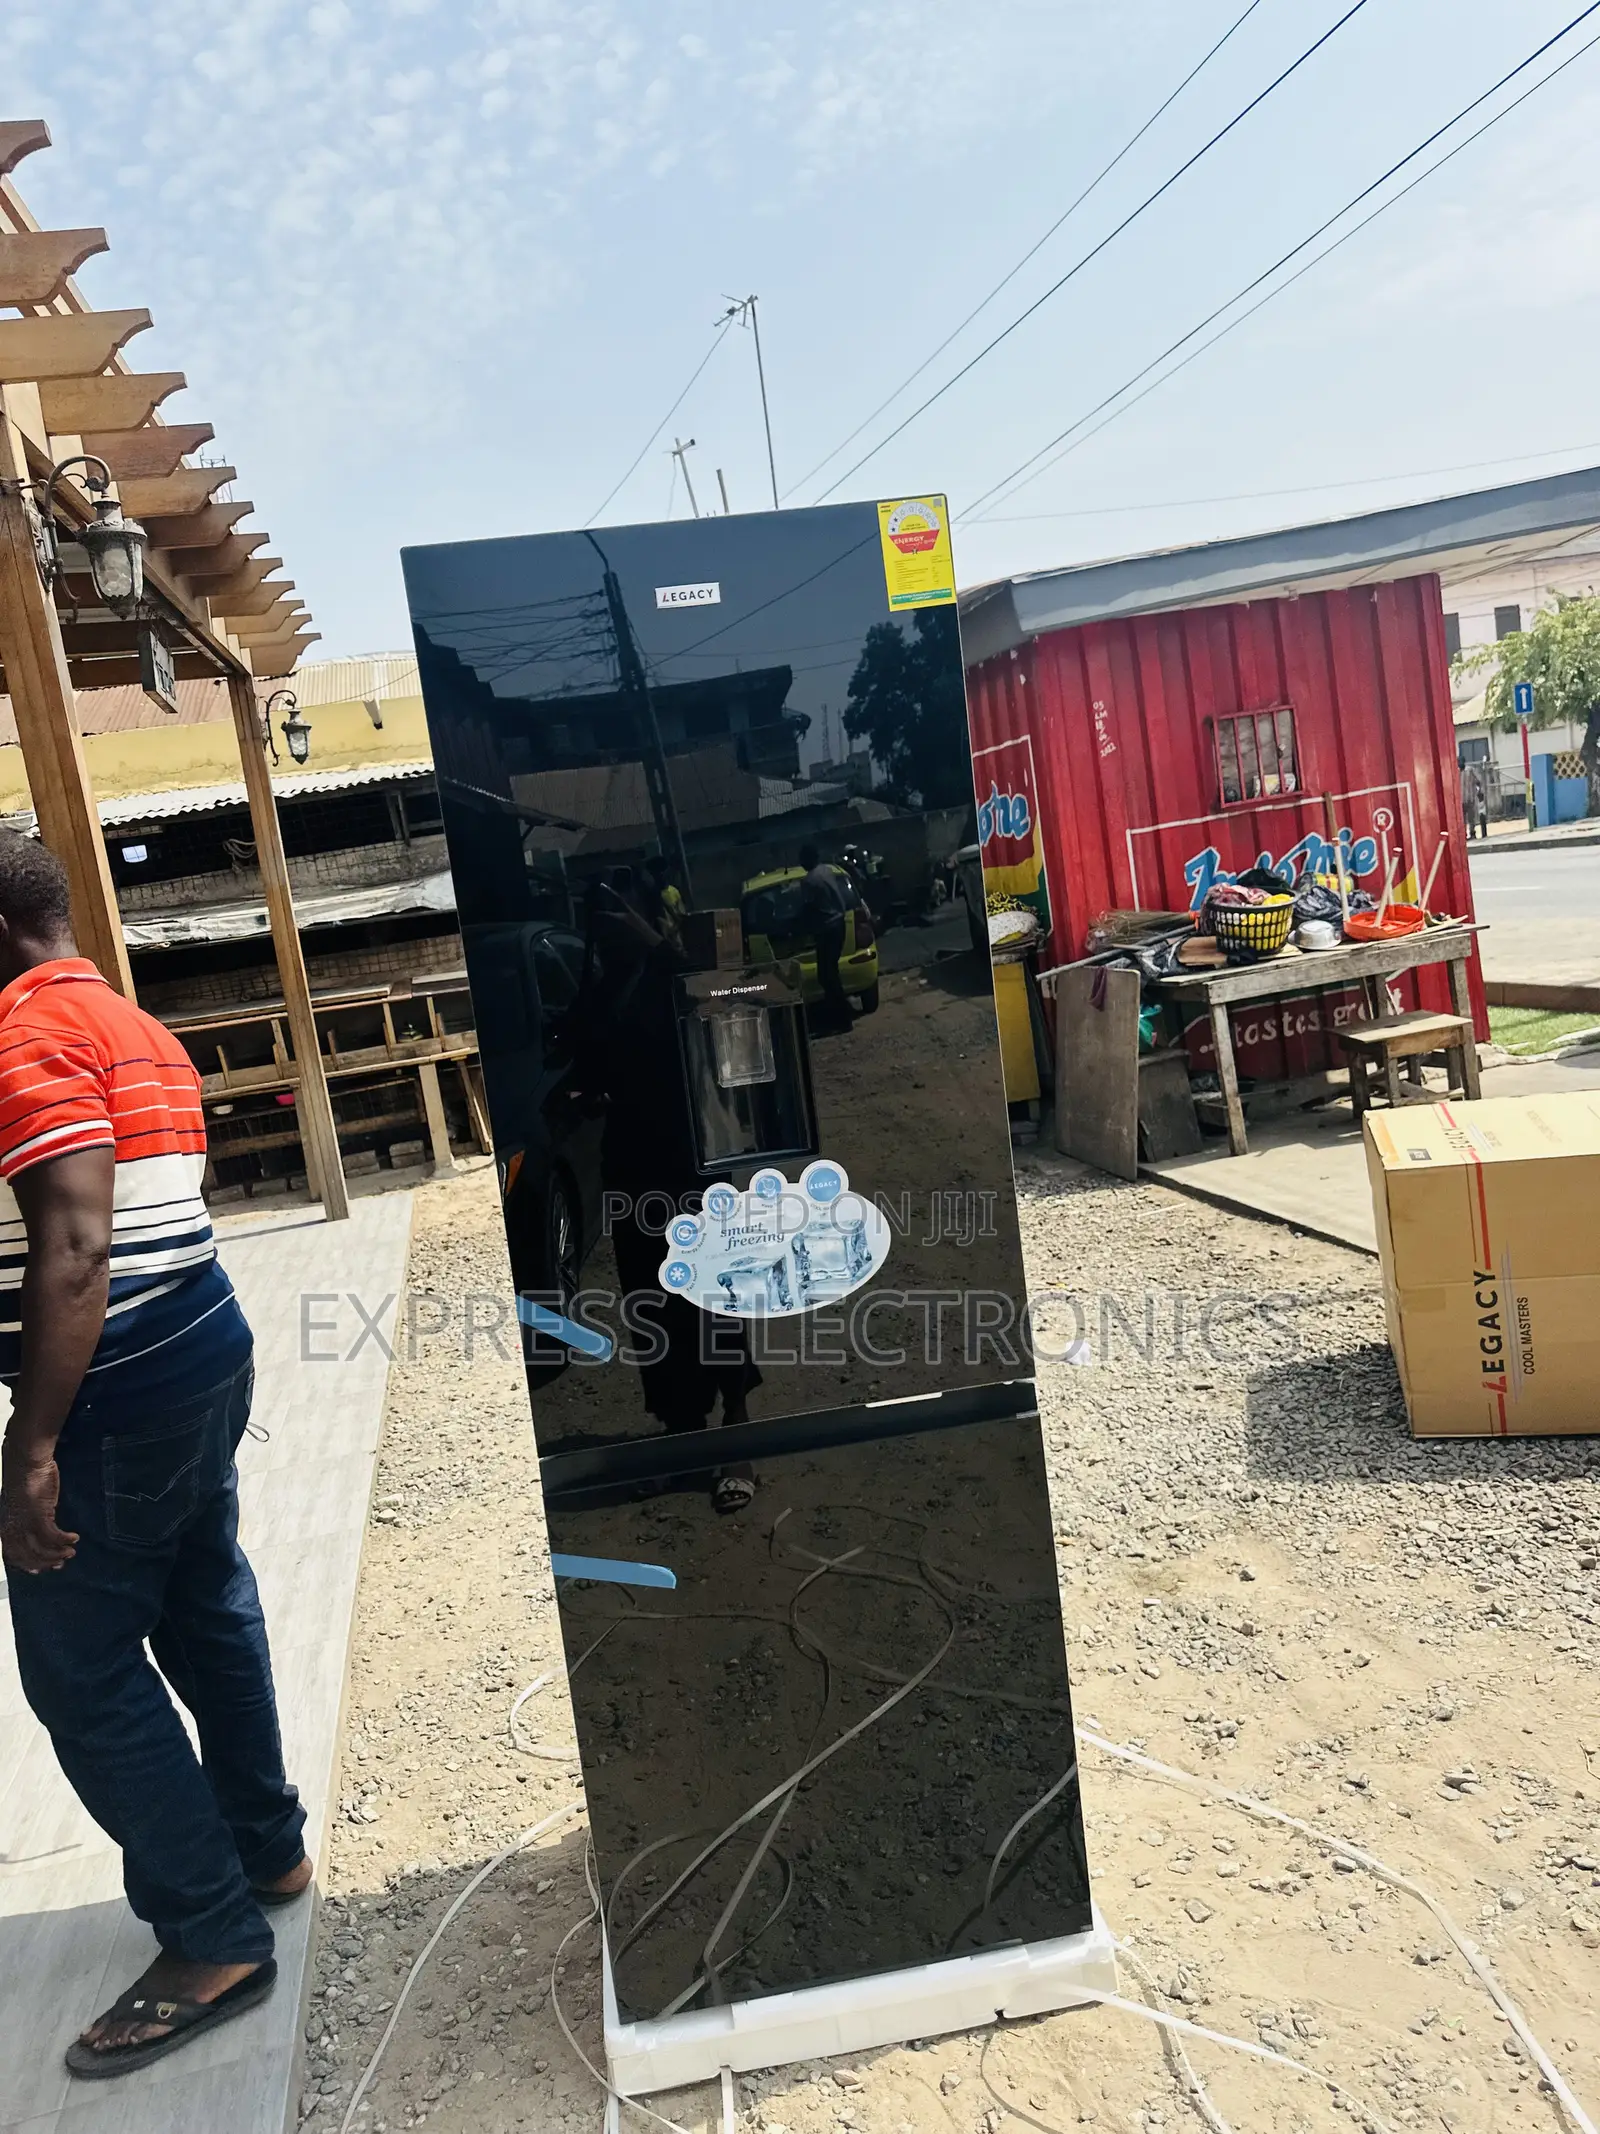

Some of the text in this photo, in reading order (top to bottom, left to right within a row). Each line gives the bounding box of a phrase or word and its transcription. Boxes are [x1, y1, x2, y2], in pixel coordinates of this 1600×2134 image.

[662, 588, 714, 602] LEGACY
[710, 984, 767, 997] Water Dispenser
[810, 1180, 838, 1190] LEGACY
[720, 1221, 763, 1238] smart
[725, 1231, 785, 1252] freezing
[1473, 1270, 1508, 1394] LEGACY
[1517, 1296, 1535, 1375] COOL MASTERS
